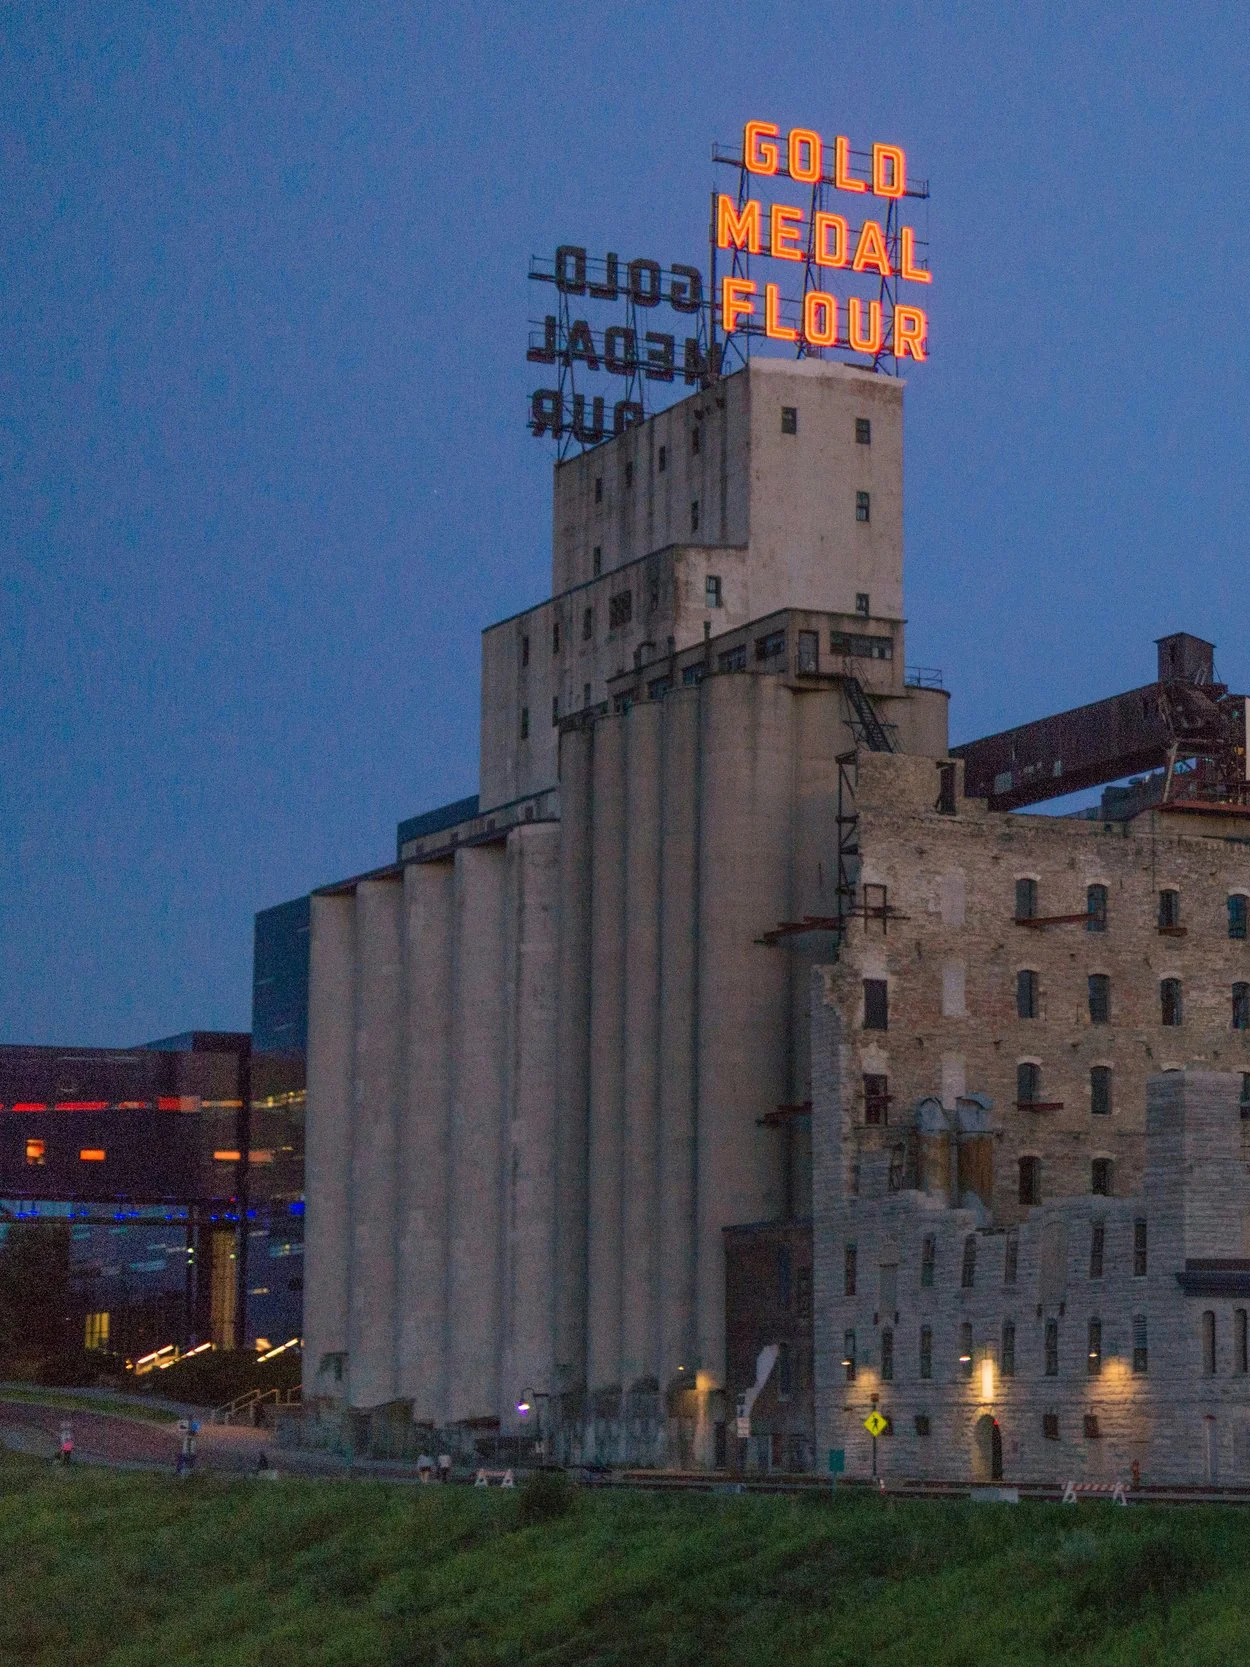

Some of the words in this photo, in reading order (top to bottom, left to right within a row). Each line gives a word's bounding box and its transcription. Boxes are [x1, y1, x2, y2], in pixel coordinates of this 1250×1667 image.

[744, 120, 907, 198] GOLD
[717, 194, 932, 283] MEDAL
[721, 276, 928, 361] FLOUR
